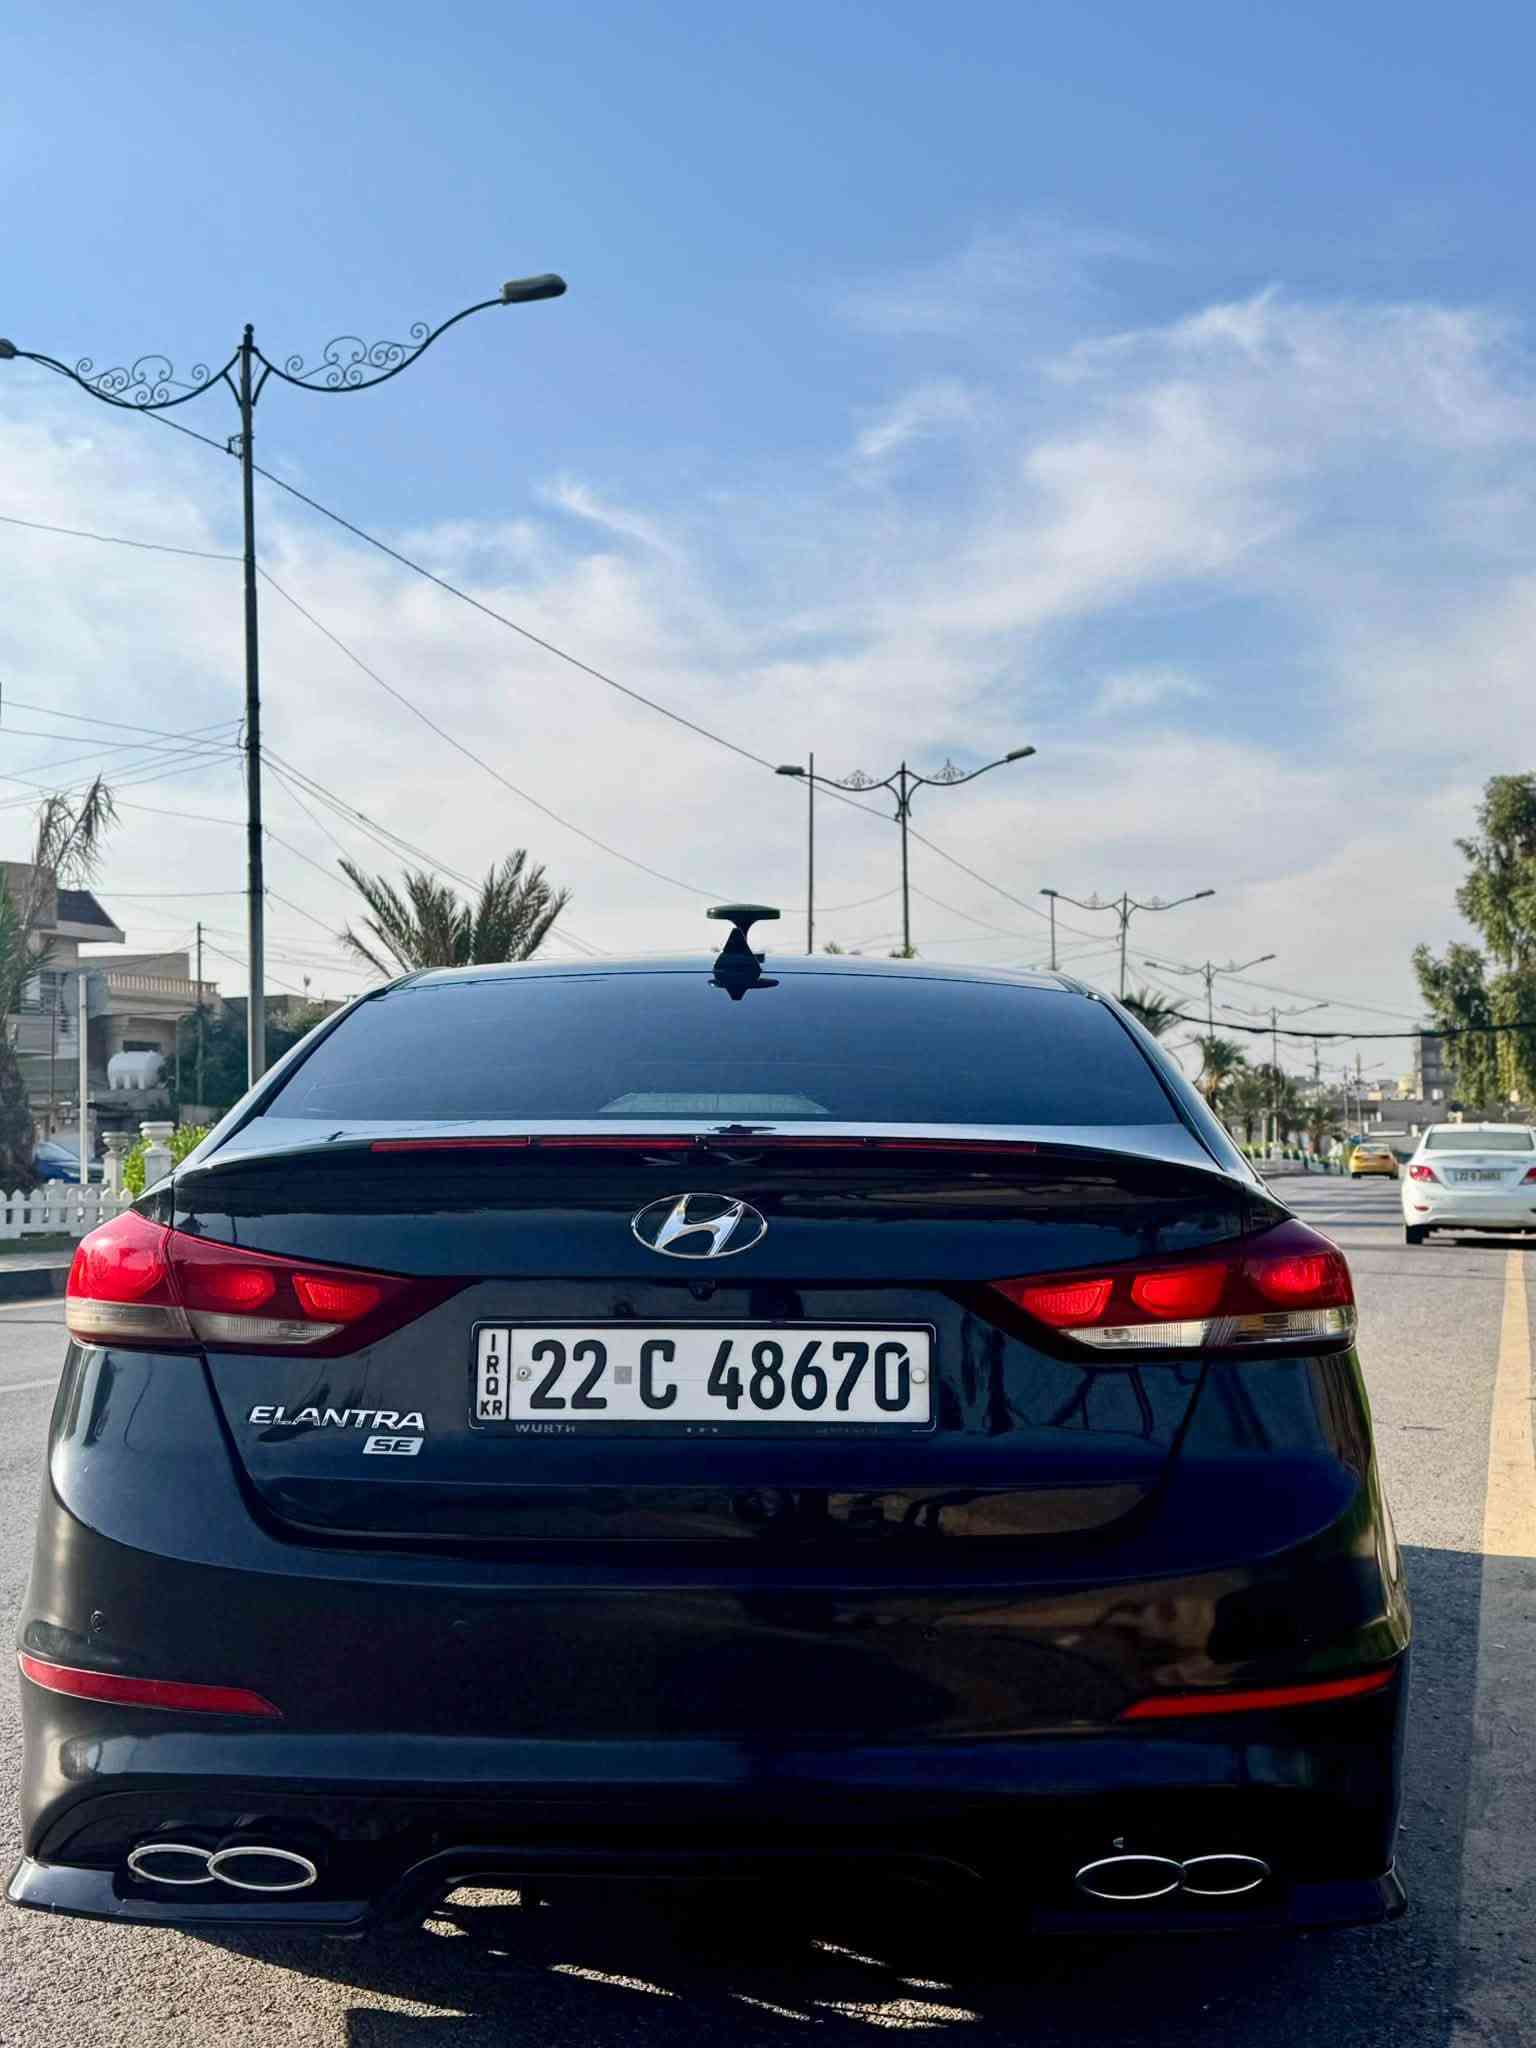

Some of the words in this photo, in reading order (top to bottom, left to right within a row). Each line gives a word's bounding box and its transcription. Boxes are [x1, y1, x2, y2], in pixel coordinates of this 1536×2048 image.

[529, 1339, 608, 1410] 22
[639, 1339, 678, 1410] C
[707, 1339, 911, 1412] 48670
[480, 1400, 503, 1416] KR
[249, 1406, 425, 1431] ELANTRA
[371, 1438, 414, 1453] SE
